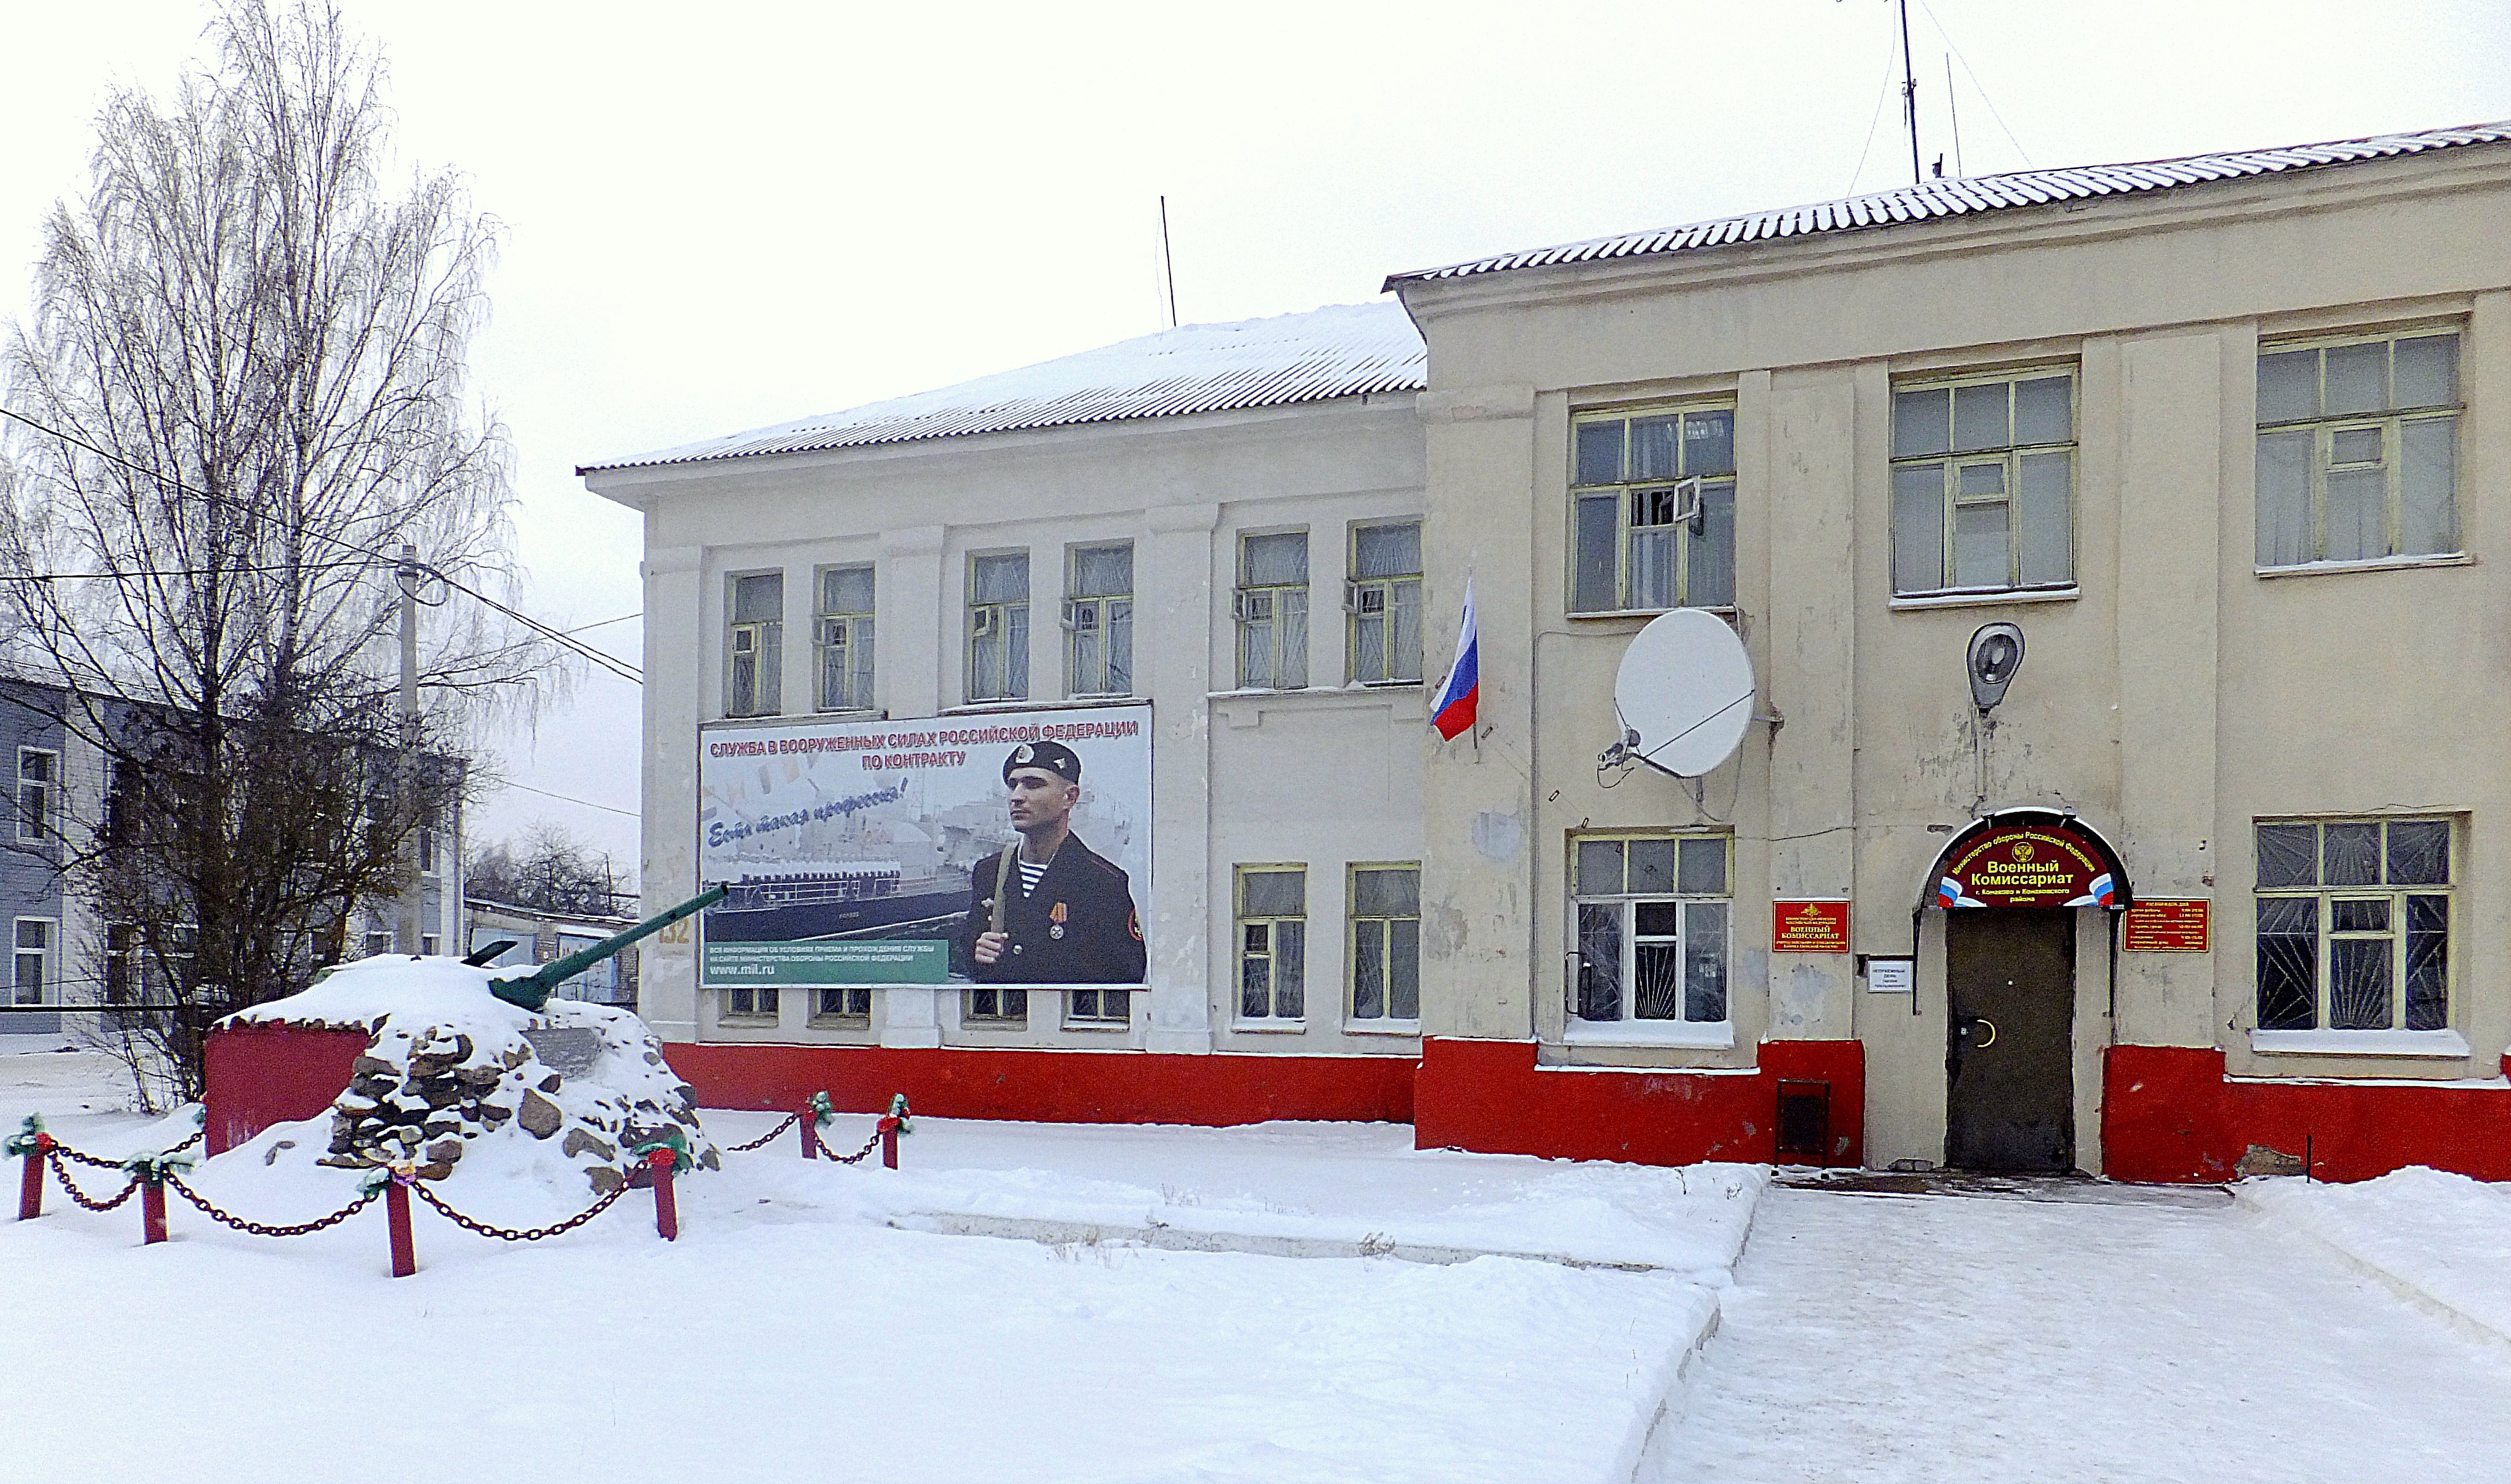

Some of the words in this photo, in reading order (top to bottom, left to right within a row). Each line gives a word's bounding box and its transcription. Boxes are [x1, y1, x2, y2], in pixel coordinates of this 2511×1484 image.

[710, 740, 766, 758] СЛУЖБА
[768, 739, 777, 755] В
[779, 735, 884, 753] ВООРУЖЕННЫХ
[887, 731, 937, 748] СИЛАХ
[940, 724, 1041, 745] РОССИЙСКОЙ
[1042, 720, 1139, 740] ФЕДЕРАЦИИ
[862, 755, 883, 770] ПО
[884, 751, 966, 770] КОНТРАКТУ
[708, 822, 752, 847] Есть
[756, 809, 810, 833] такая
[813, 776, 908, 822] профессия!
[1952, 841, 1992, 876] Министерство
[1993, 832, 2024, 845] обороны
[2025, 831, 2065, 847] Российской
[2065, 842, 2096, 873] Федерации
[1987, 860, 2059, 874] Военный
[1971, 874, 2074, 887] Комиссариат
[709, 964, 775, 975] www.mil.ru
